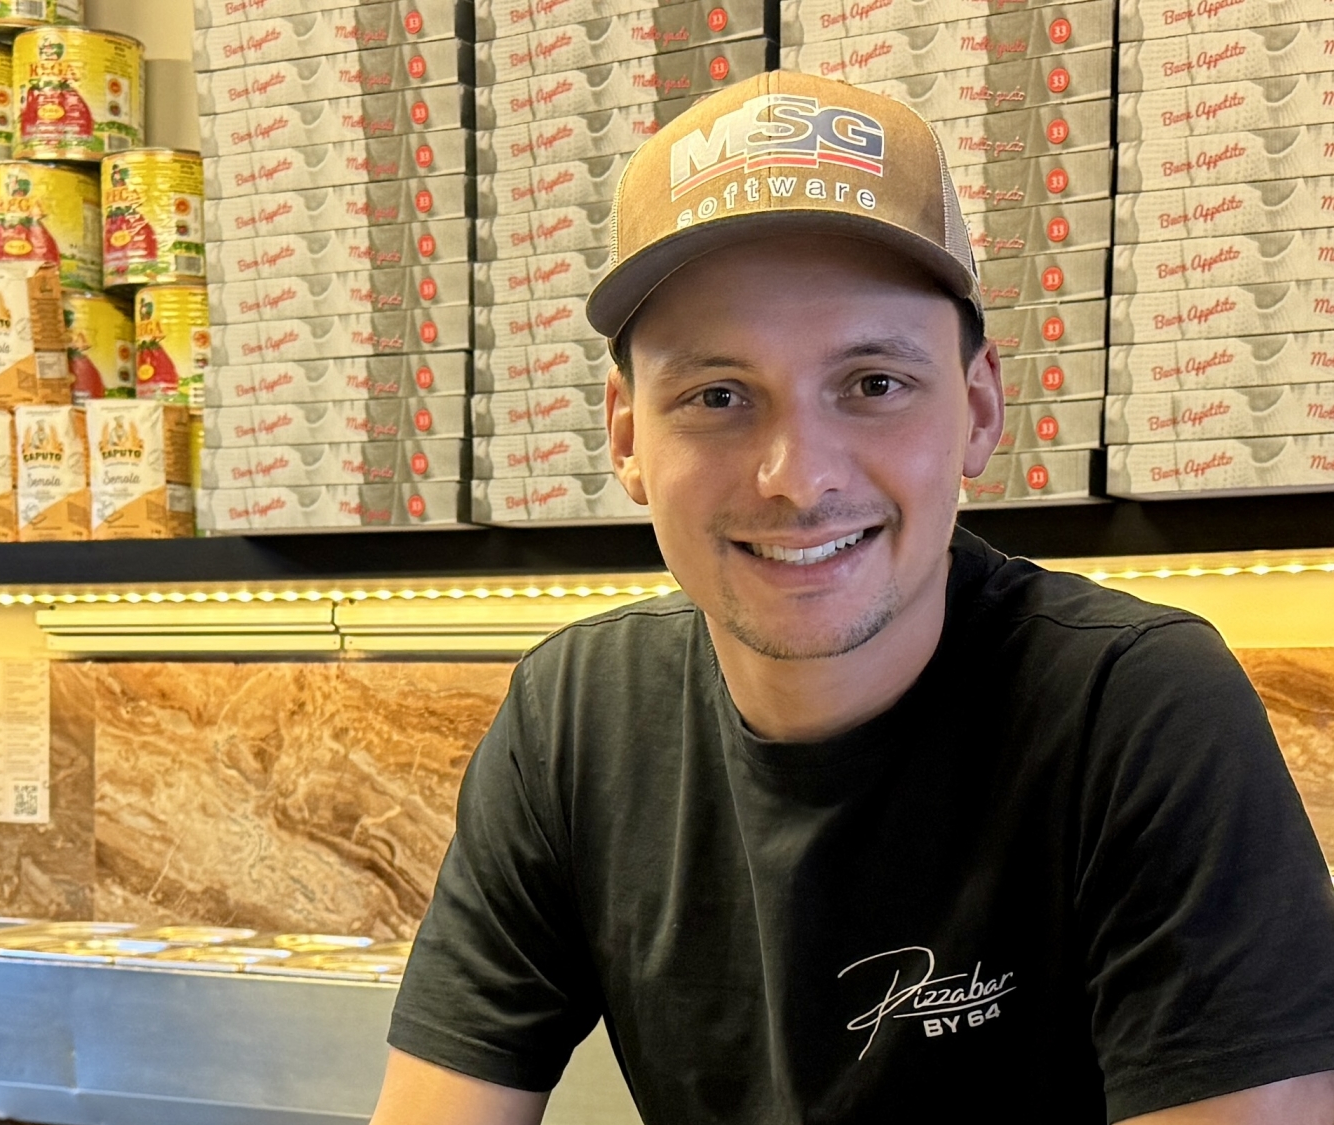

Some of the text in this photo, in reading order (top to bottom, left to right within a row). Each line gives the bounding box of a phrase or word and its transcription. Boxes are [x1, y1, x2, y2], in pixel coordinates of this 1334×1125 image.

[850, 43, 893, 67] Appetito
[1160, 94, 1245, 126] Buon Appetito
[670, 93, 886, 188] MSG
[675, 176, 877, 229] software
[1158, 197, 1243, 228] Buon Appetito
[1153, 299, 1236, 329] Buon Appetito
[22, 451, 62, 464] CAPUTO
[101, 448, 142, 461] CAPUTO
[1150, 454, 1233, 481] Buon Appetito
[26, 472, 62, 488] Semola
[101, 470, 141, 486] Semola
[837, 945, 1016, 1060] Pizzabar
[923, 1002, 1002, 1038] BY 64
